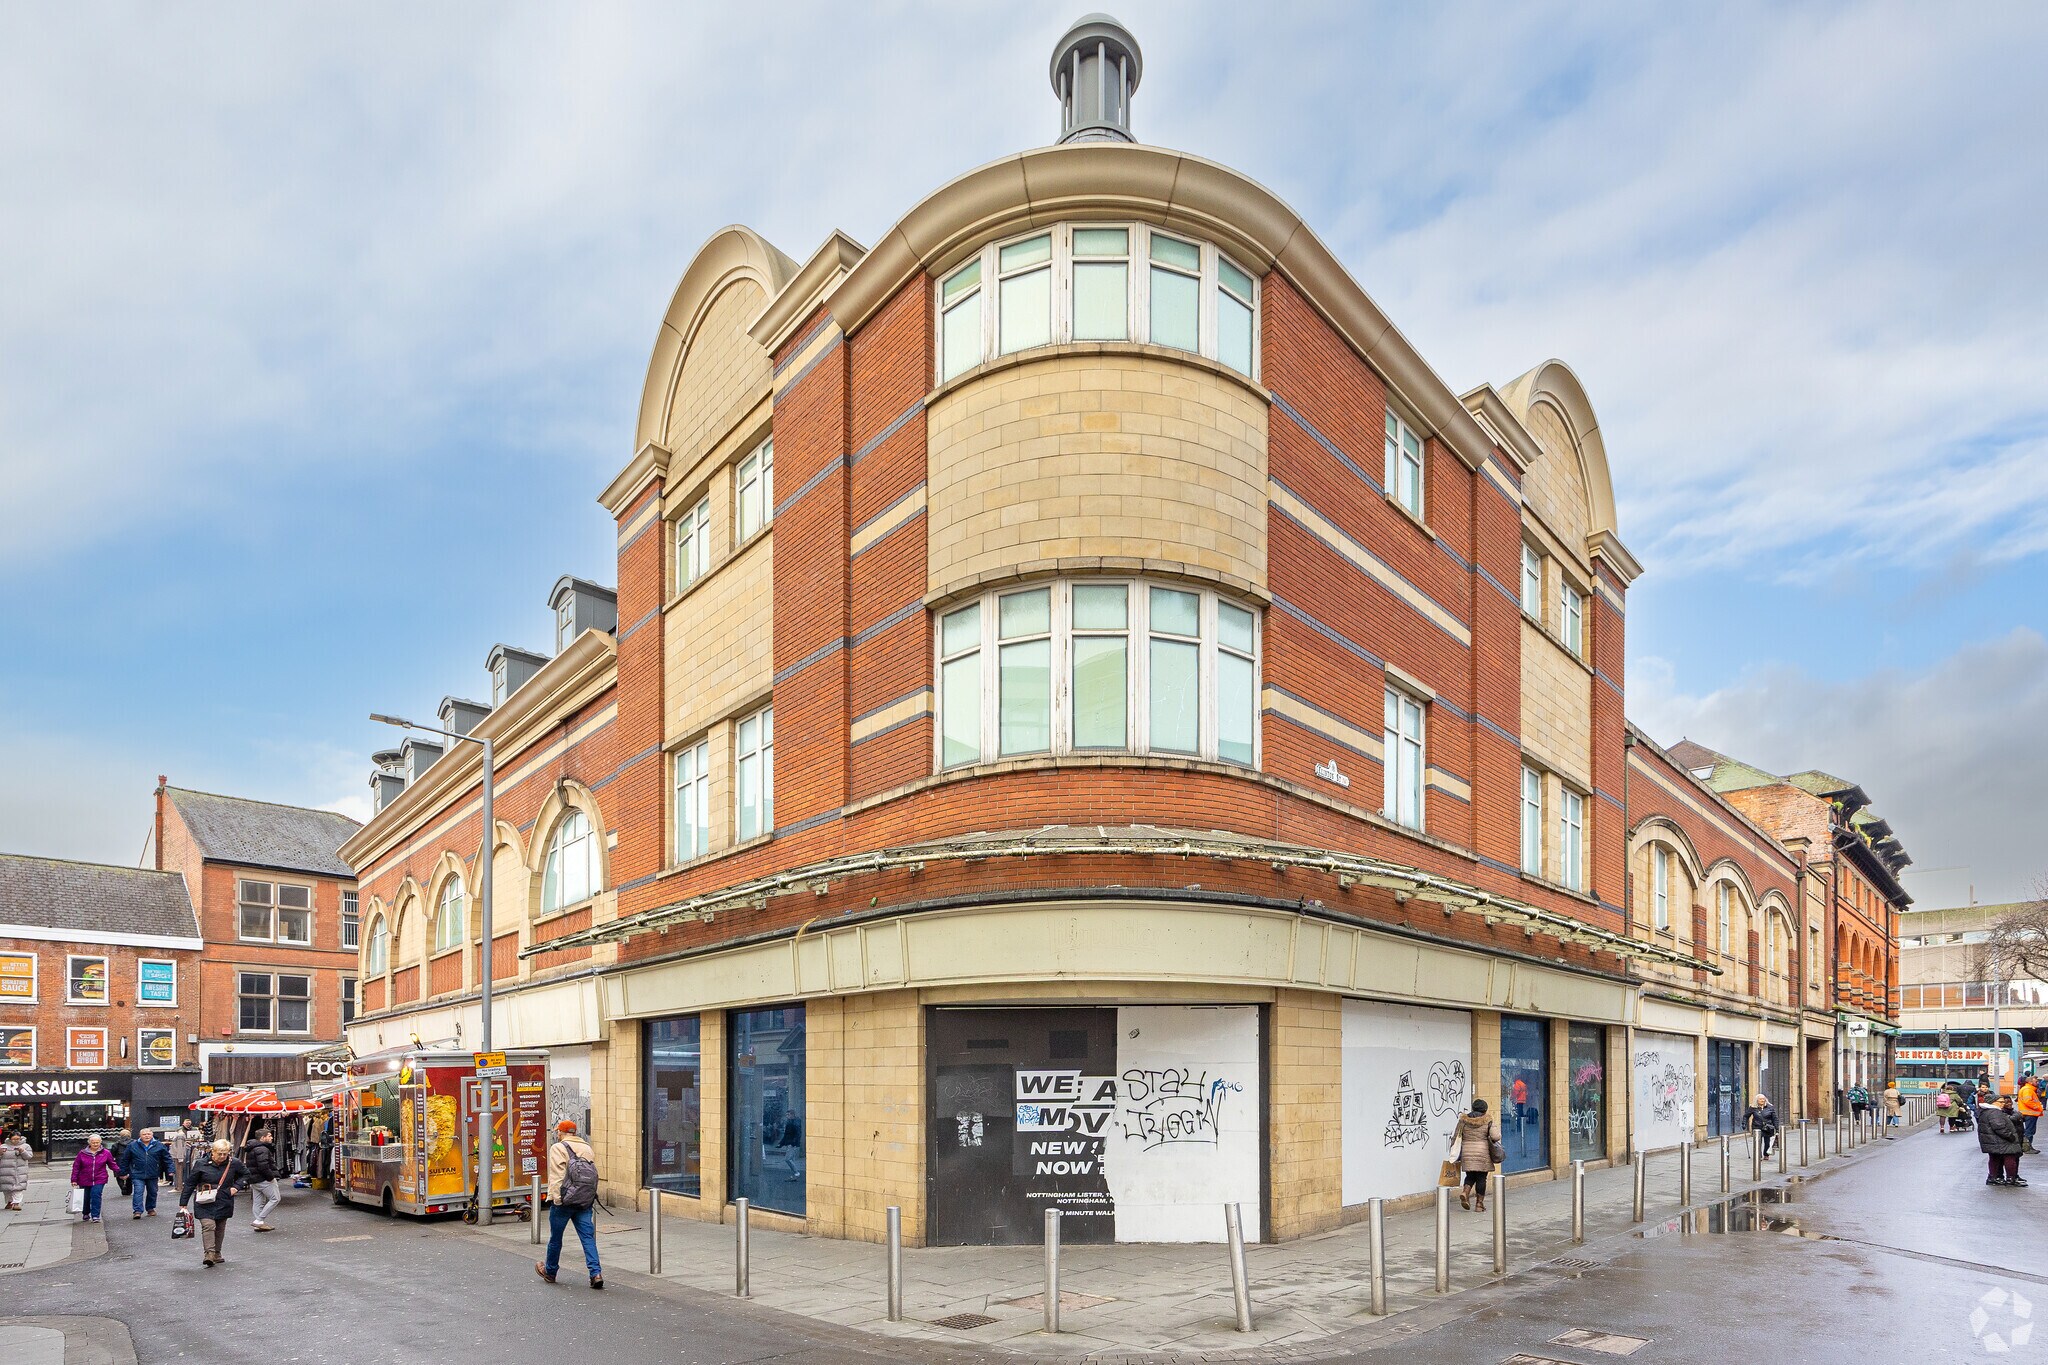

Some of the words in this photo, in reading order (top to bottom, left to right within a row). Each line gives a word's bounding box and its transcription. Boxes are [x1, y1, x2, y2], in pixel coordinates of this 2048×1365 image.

[1936, 1051, 1963, 1059] BSES
[1966, 1051, 1983, 1059] APP
[306, 1062, 348, 1076] FOO
[1030, 1142, 1086, 1154] NEW
[352, 1161, 376, 1179] SULTAN
[1036, 1161, 1094, 1175] NOW
